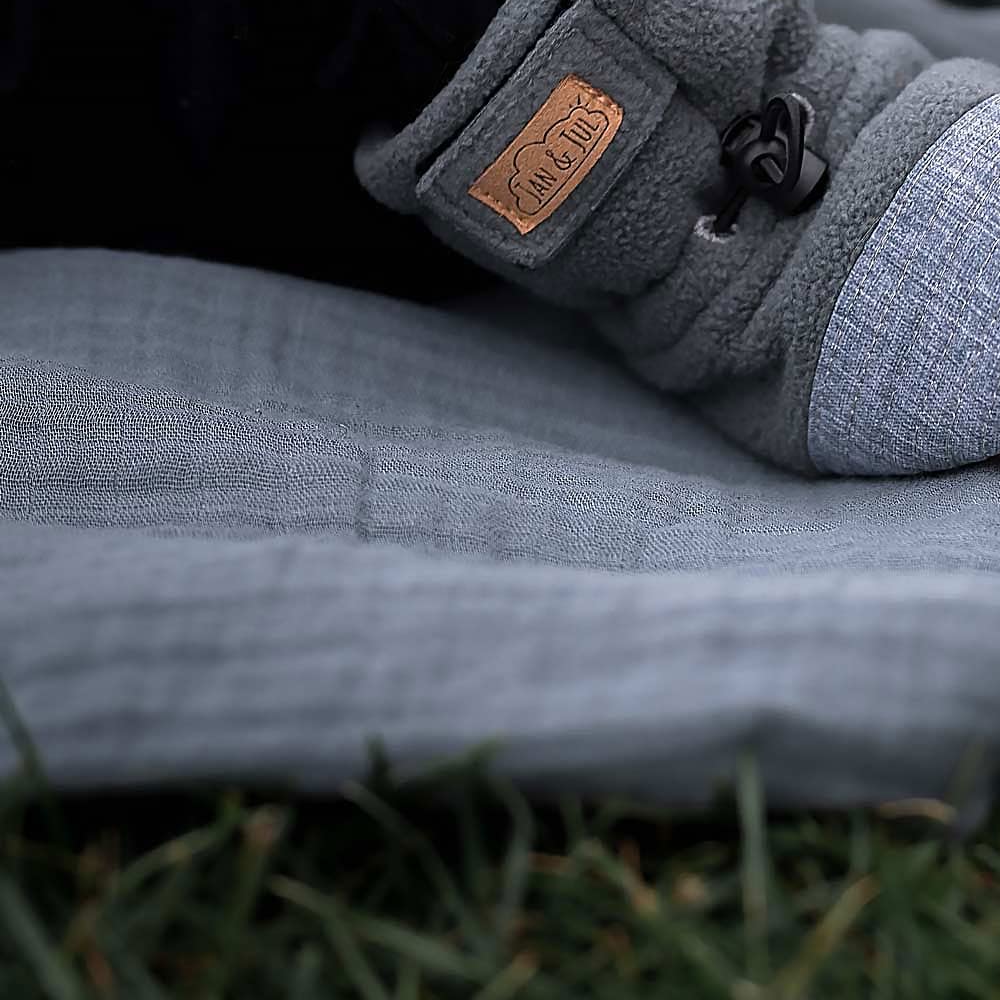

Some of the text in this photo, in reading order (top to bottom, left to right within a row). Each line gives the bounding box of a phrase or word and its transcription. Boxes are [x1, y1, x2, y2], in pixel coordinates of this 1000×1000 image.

[515, 117, 599, 204] JAN & JUL
